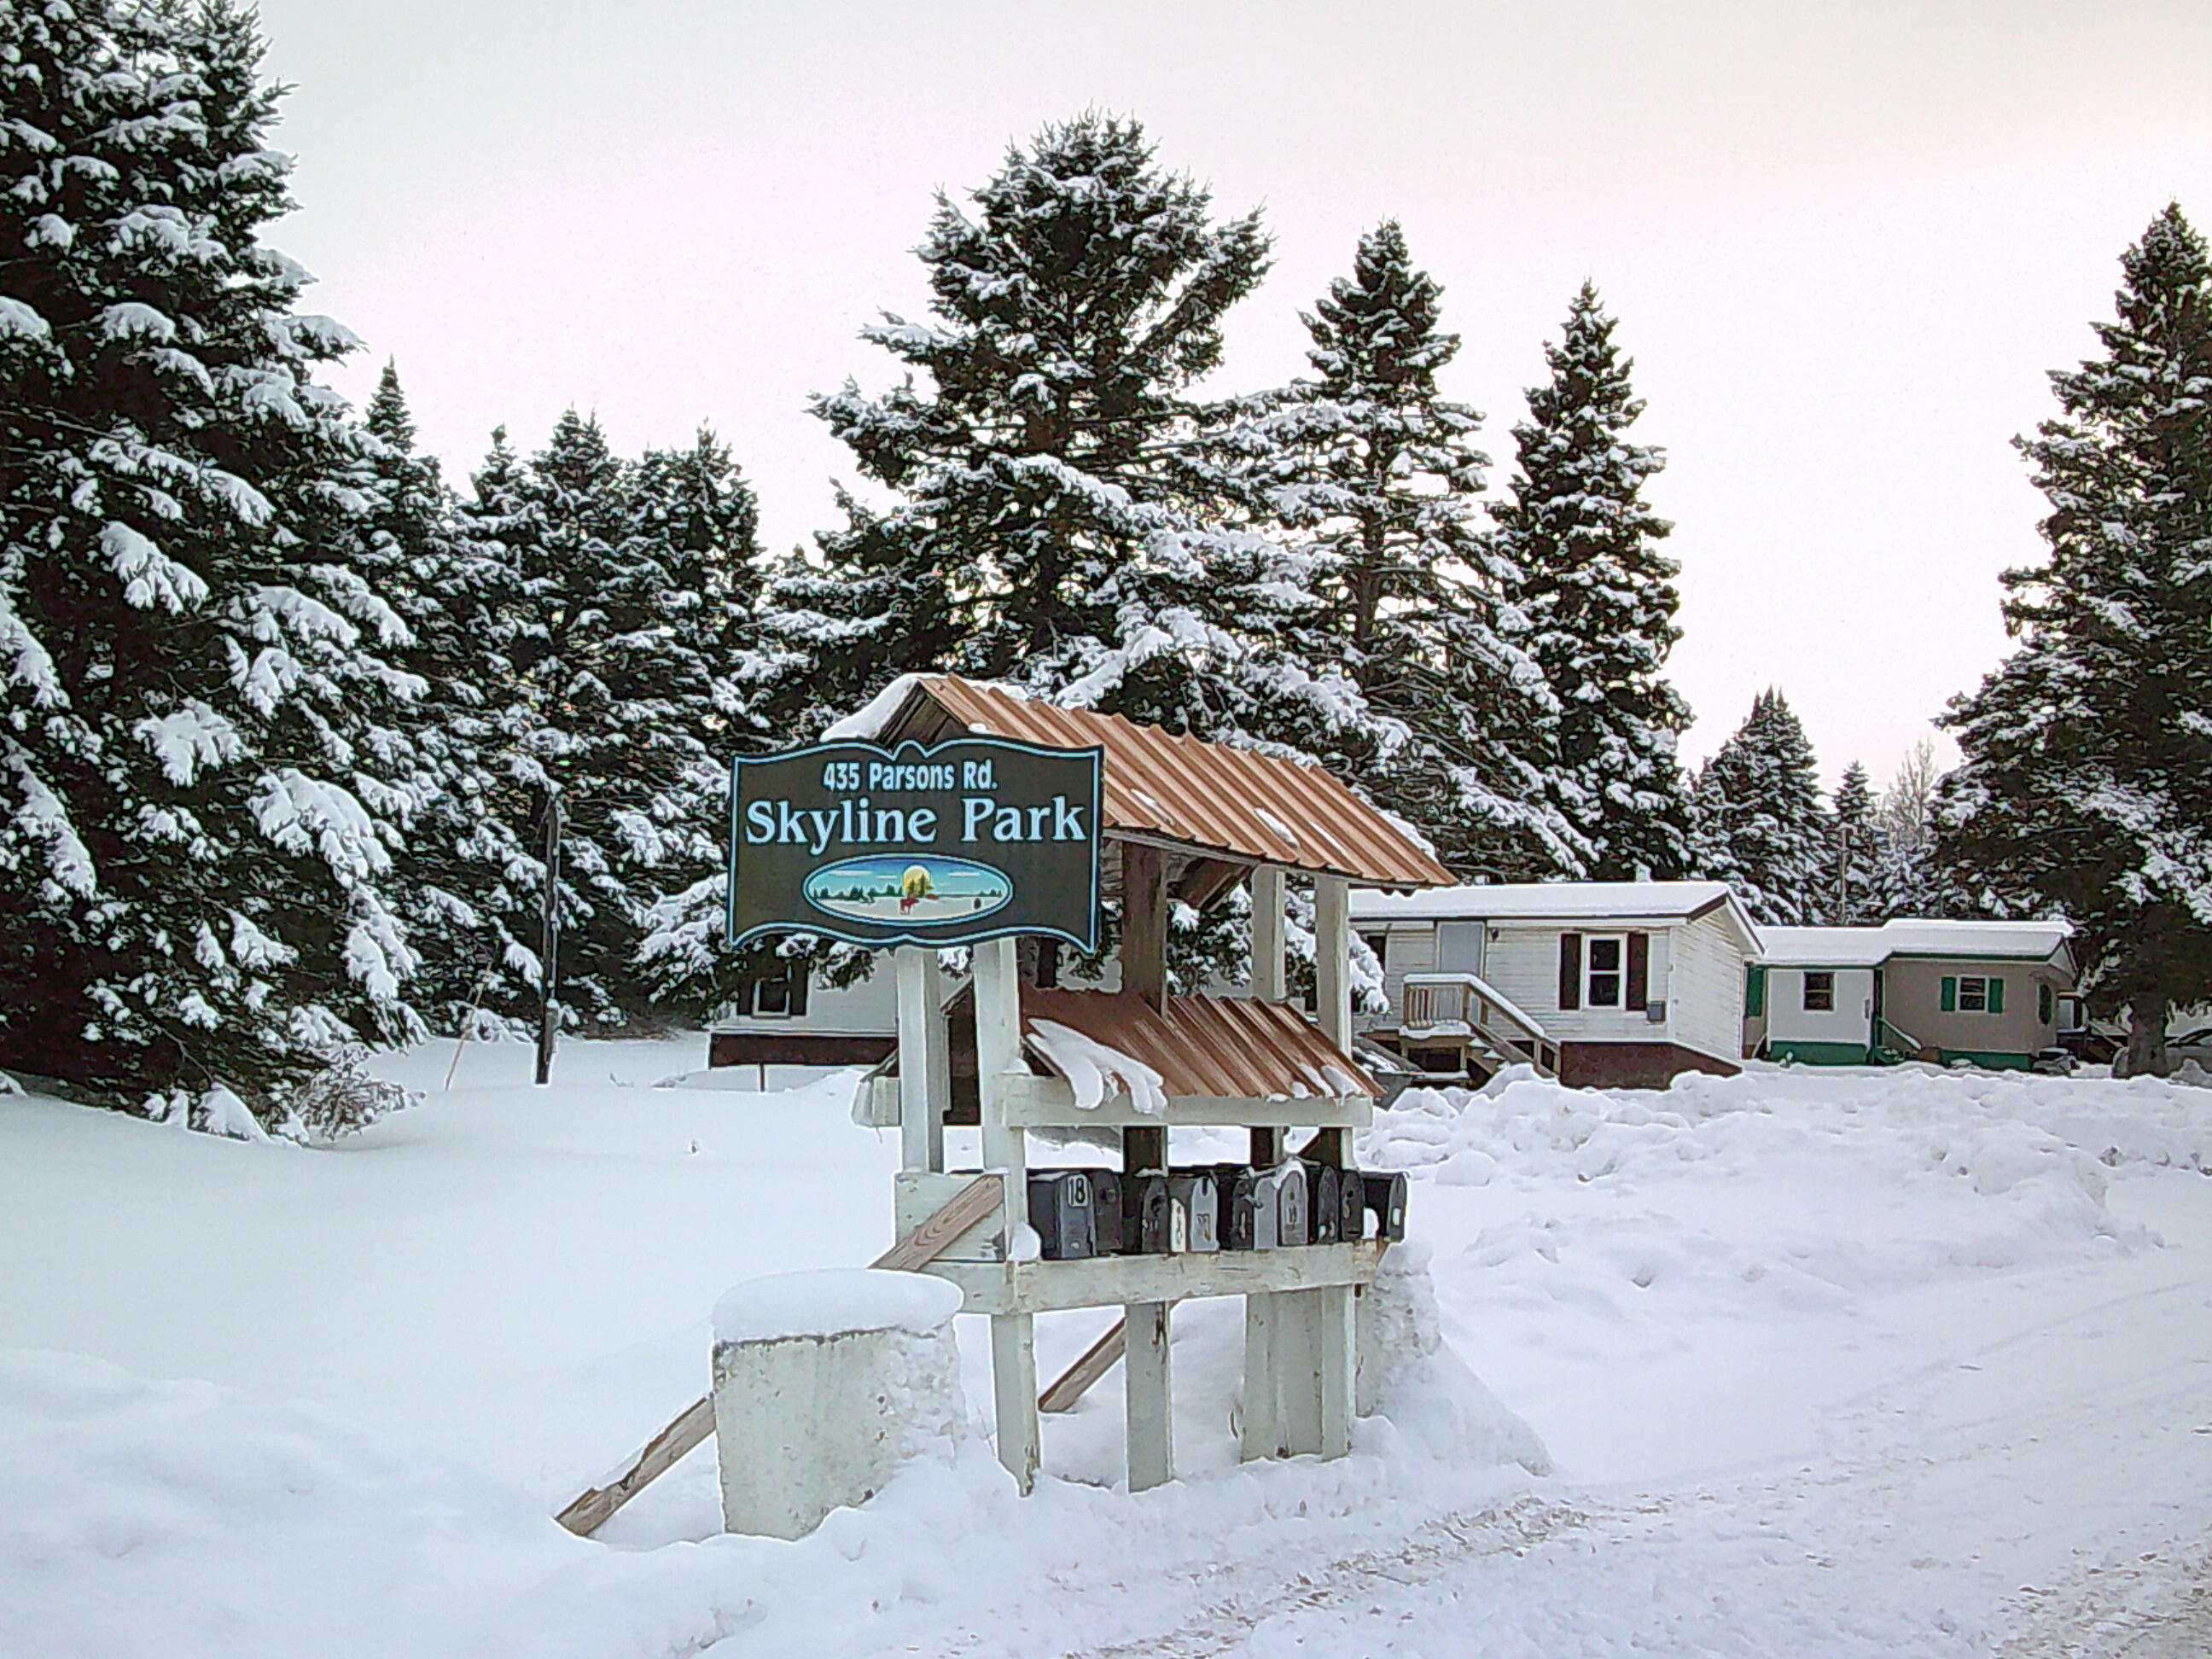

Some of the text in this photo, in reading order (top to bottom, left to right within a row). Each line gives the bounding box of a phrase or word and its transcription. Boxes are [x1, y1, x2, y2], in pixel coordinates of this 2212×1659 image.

[824, 760, 998, 790] 435 Parsons Rd.
[746, 796, 1087, 854] Skyline Park
[1068, 1178, 1086, 1204] 18
